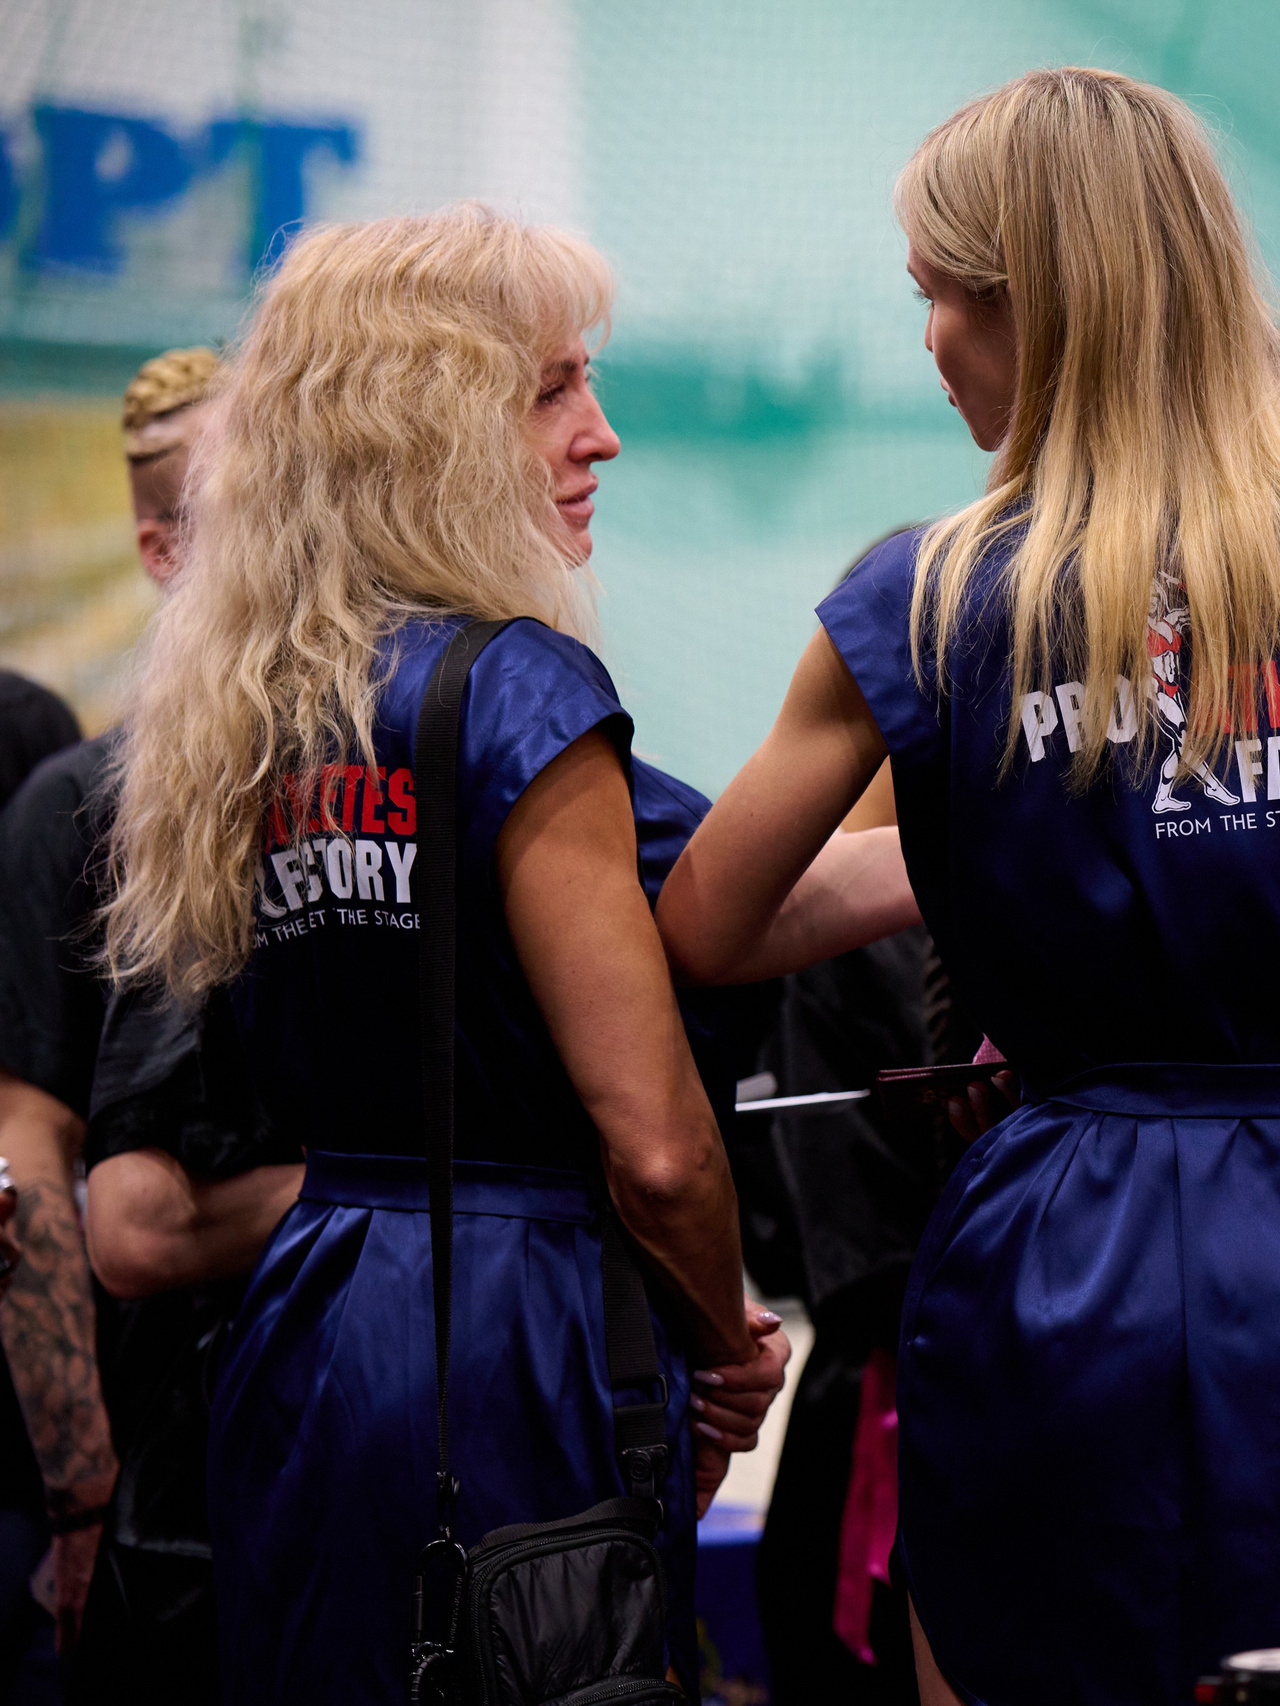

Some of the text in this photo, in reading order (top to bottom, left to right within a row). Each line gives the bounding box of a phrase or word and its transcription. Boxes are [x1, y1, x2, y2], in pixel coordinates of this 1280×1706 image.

[1155, 817, 1212, 839] FROM
[1219, 813, 1258, 832] THE
[270, 837, 418, 912] FCTORY
[336, 907, 369, 927] THE
[374, 909, 421, 931] STAGE
